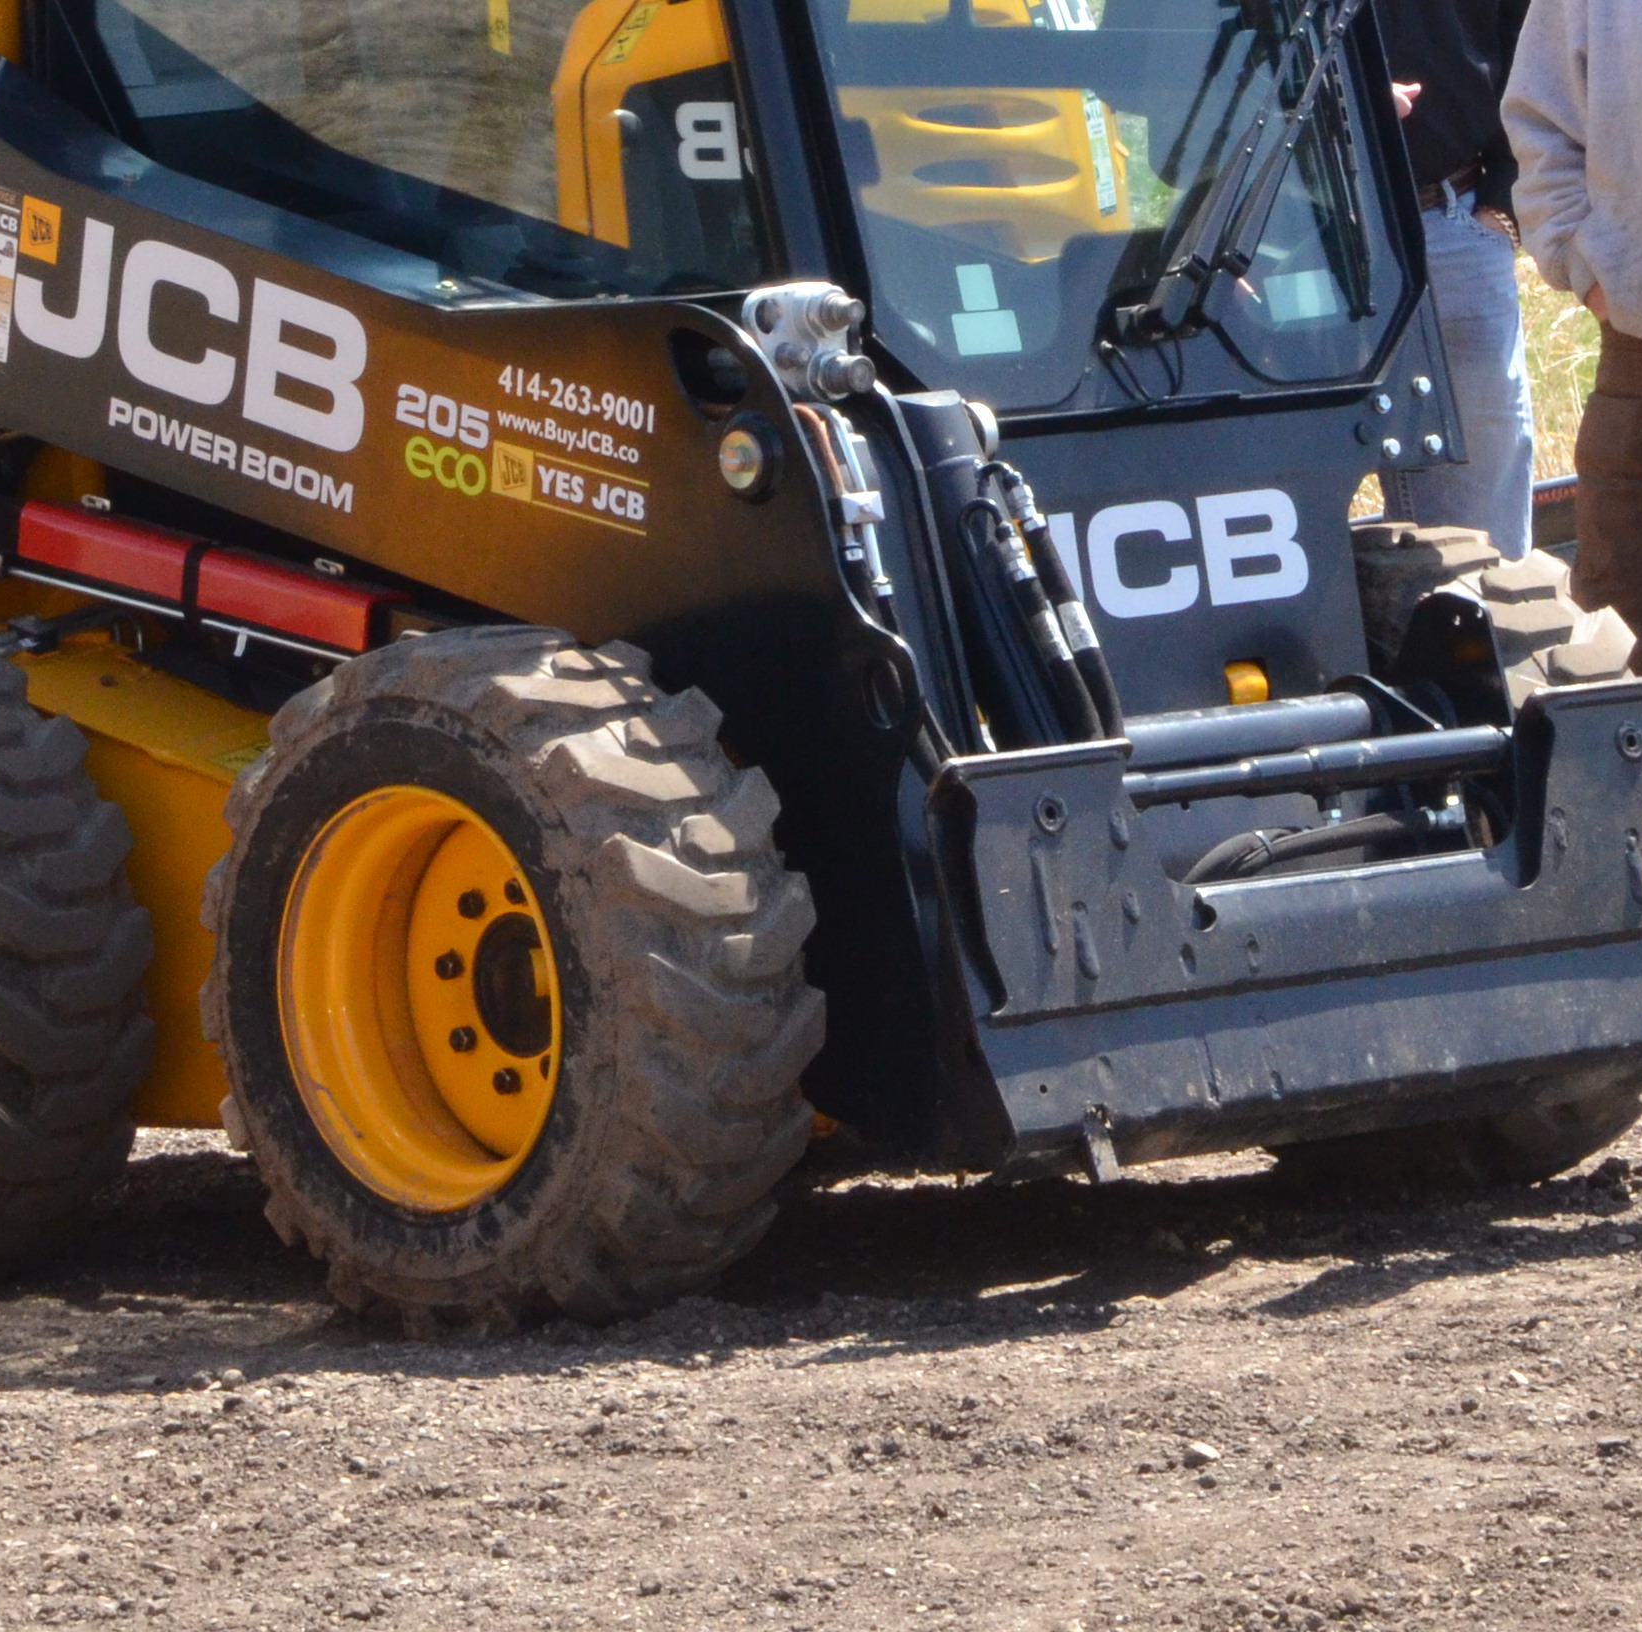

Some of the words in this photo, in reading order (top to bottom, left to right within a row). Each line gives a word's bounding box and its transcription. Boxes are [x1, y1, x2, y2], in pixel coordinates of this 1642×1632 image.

[31, 214, 53, 242] JCB
[12, 216, 368, 453] JCB
[394, 382, 491, 451] 205
[497, 363, 656, 435] 414-263-9001
[404, 434, 487, 497] eco
[496, 409, 640, 464] www.BuyJCB.co
[501, 453, 526, 488] JCB
[537, 464, 585, 505] YES
[591, 482, 645, 521] JCB
